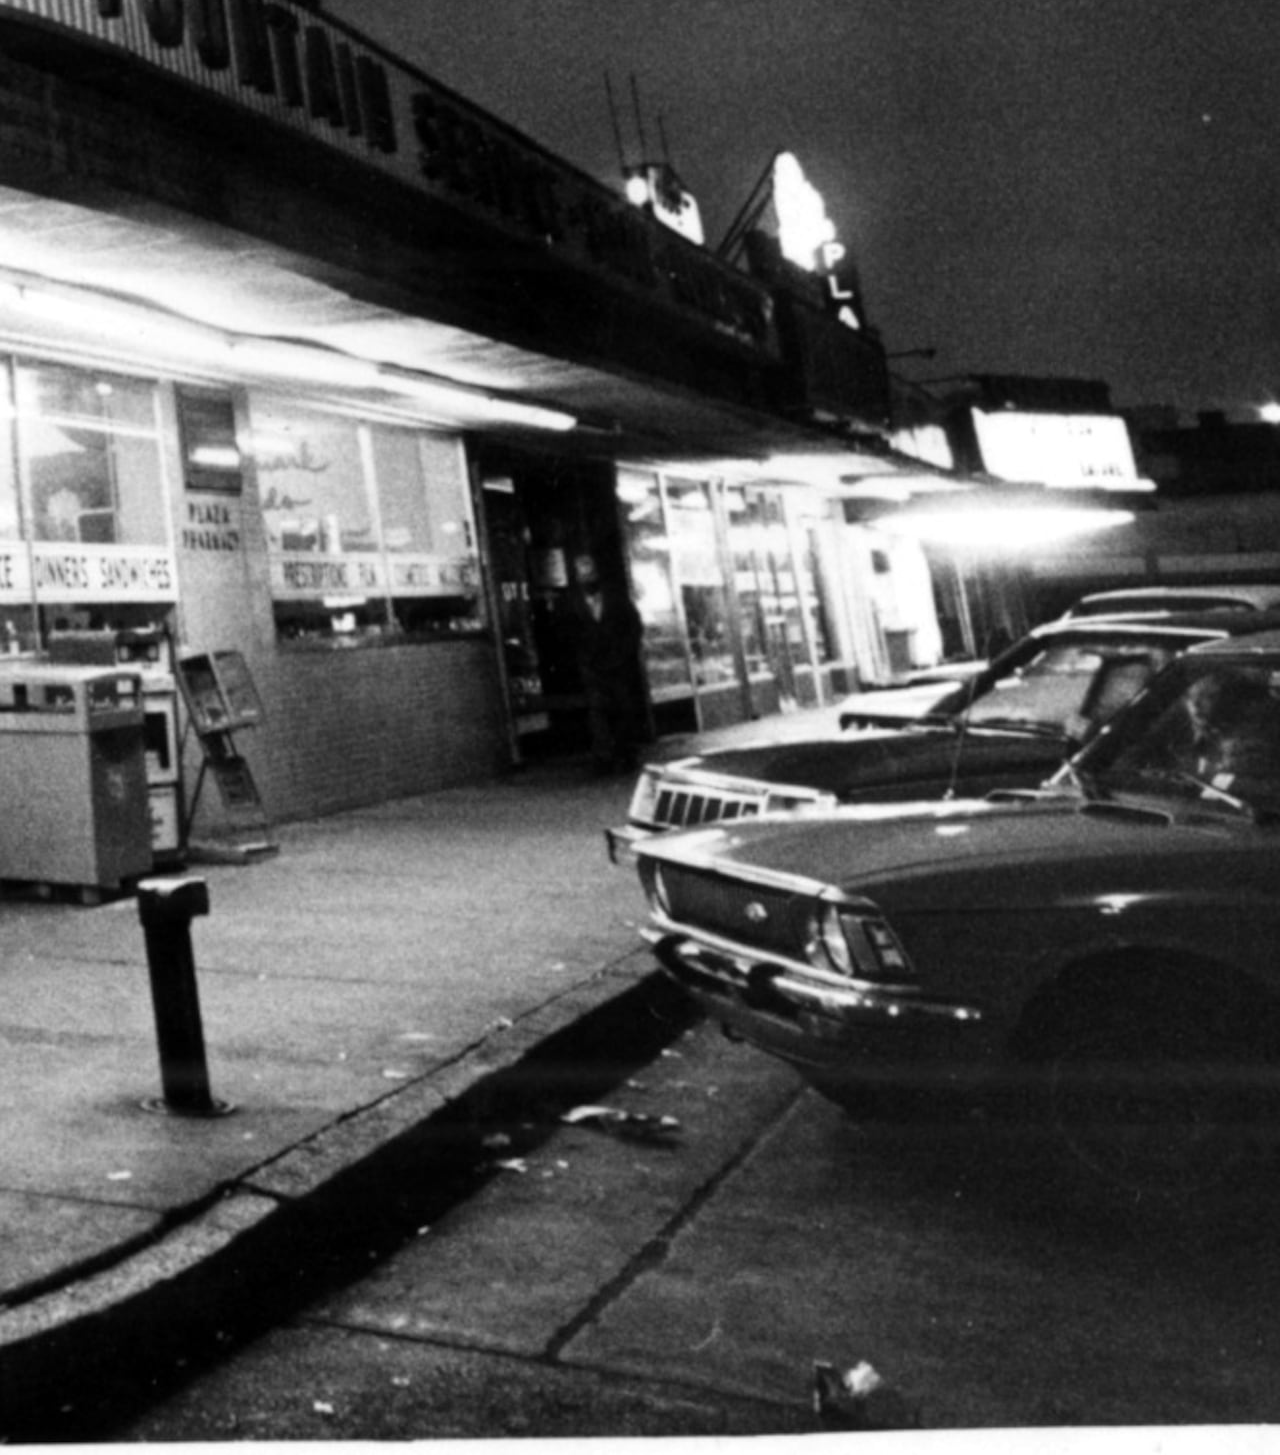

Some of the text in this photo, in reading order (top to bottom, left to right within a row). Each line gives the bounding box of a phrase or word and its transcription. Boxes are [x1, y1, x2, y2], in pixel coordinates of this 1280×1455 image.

[188, 502, 230, 524] PLAZA
[182, 530, 240, 552] PHARMACY
[35, 555, 171, 589] DINNERS SANDWICHES
